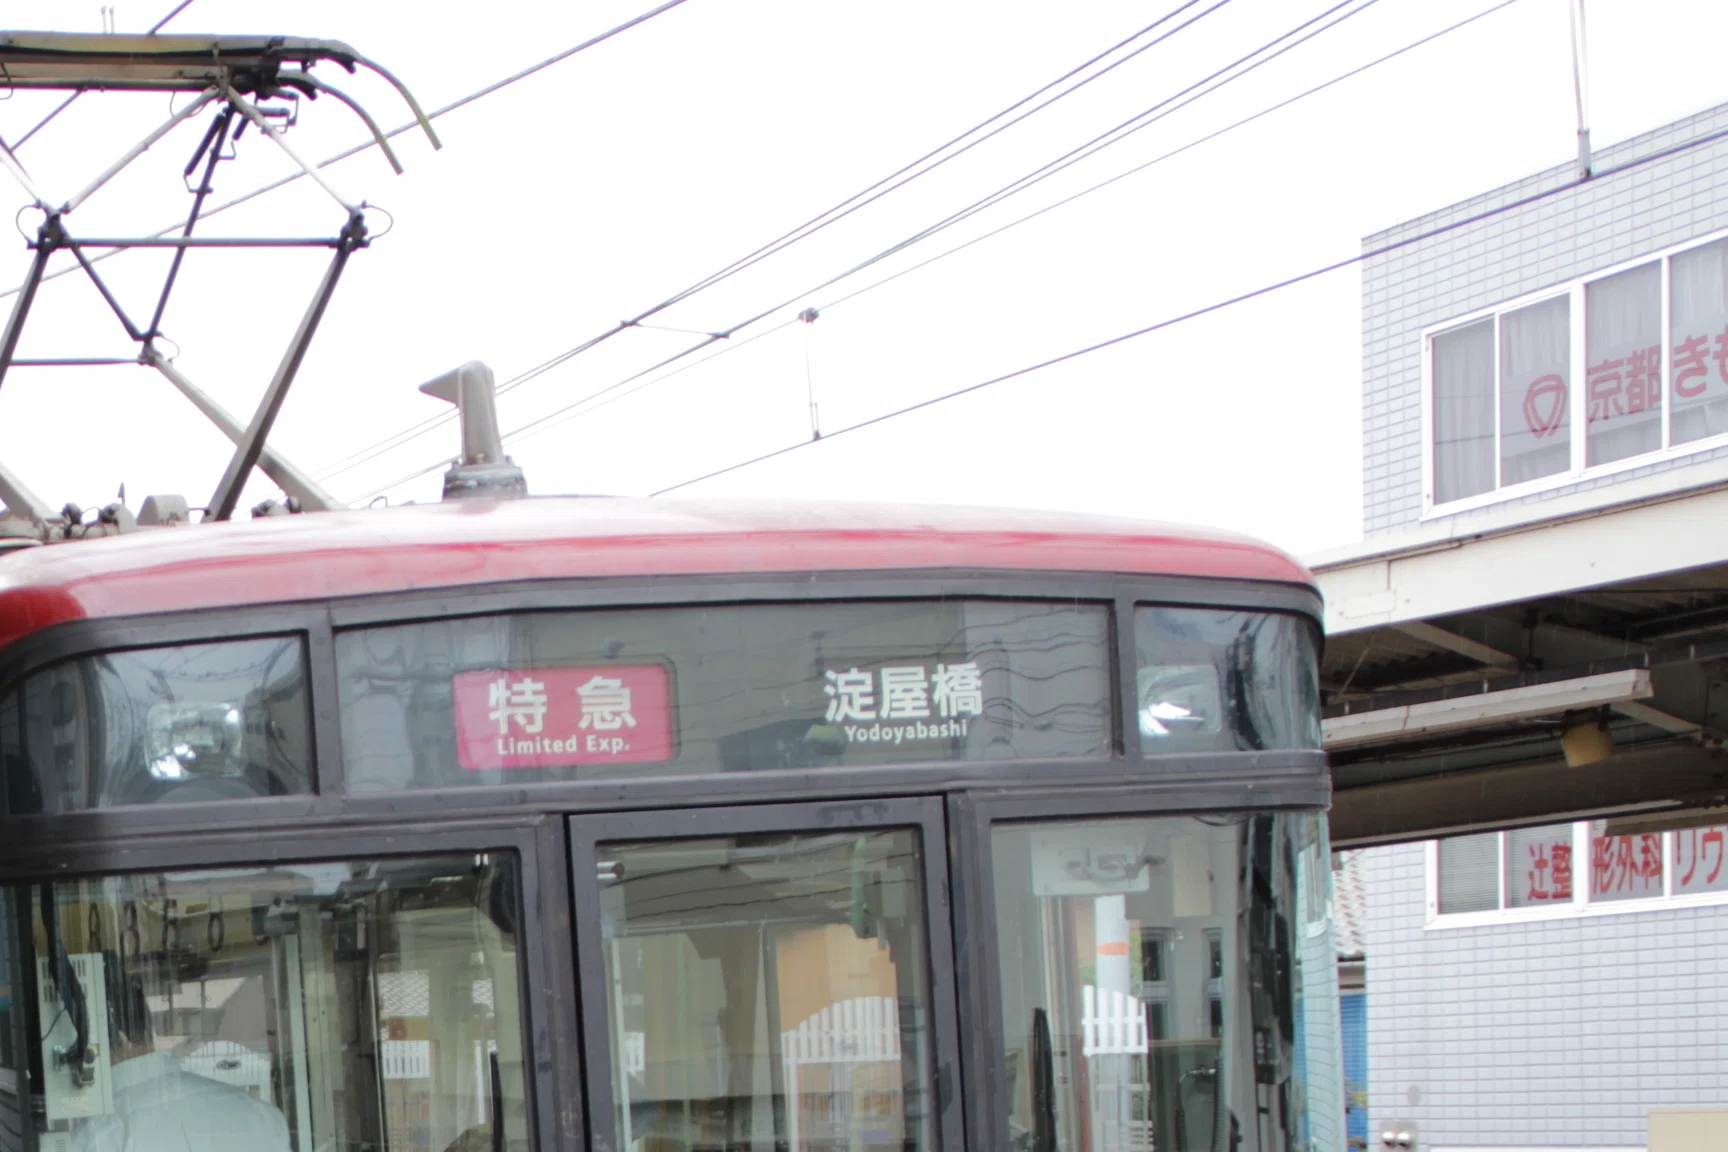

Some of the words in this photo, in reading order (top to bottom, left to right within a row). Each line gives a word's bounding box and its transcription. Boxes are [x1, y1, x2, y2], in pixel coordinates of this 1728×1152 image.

[489, 675, 638, 735] 特急
[824, 662, 983, 722] 淀屋橋
[498, 735, 578, 756] Limited
[586, 734, 631, 754] Exp.
[844, 719, 968, 745] Yodoyabashi
